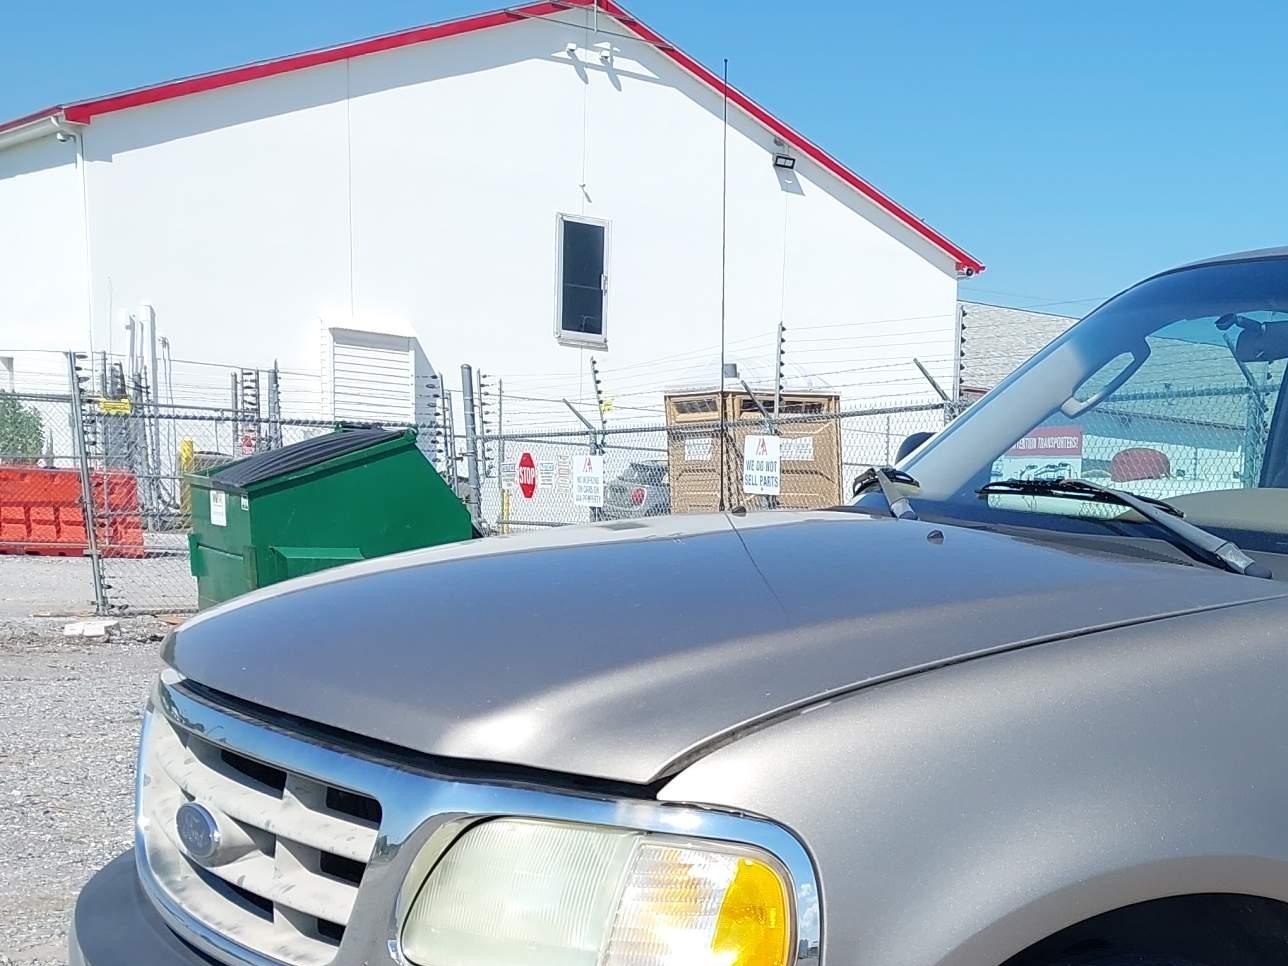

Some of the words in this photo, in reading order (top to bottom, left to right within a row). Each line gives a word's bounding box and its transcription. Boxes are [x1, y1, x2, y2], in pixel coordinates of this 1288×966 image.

[746, 460, 756, 471] WE
[519, 466, 536, 484] STOP
[745, 474, 758, 486] SELL
[760, 475, 778, 488] PARTS
